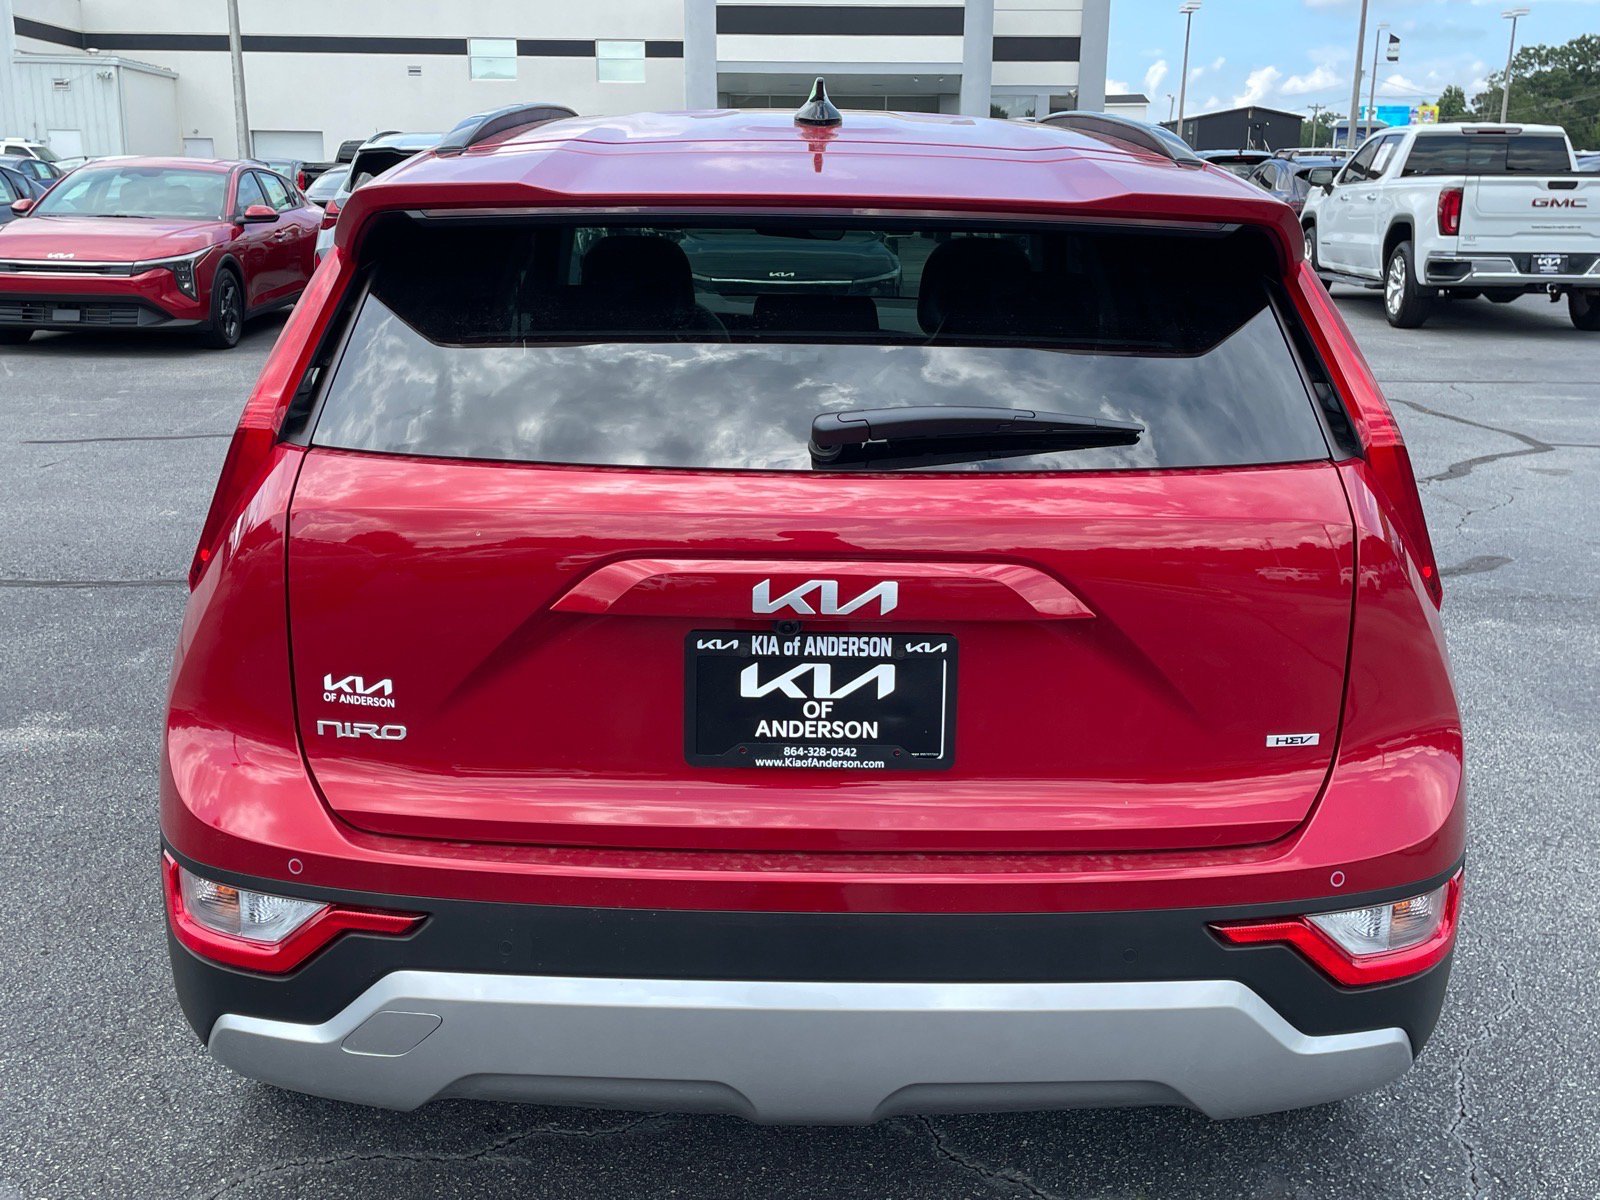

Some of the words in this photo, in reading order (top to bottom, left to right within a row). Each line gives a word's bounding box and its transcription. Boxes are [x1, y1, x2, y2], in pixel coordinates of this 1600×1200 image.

[1532, 198, 1588, 208] GMC
[752, 578, 899, 616] KIA
[696, 638, 739, 650] KIA
[751, 635, 779, 656] KIA
[783, 636, 800, 656] of
[804, 636, 892, 657] ANDERSON
[905, 642, 947, 653] KIA
[323, 673, 393, 696] KIA
[740, 662, 896, 700] KIA
[323, 692, 337, 702] OF
[339, 694, 395, 708] ANDERSON
[802, 701, 834, 719] OF
[316, 720, 407, 741] NIRO
[754, 720, 878, 739] ANDERSON
[1276, 736, 1313, 745] HEV
[783, 747, 857, 757] 864-328-0542
[754, 757, 885, 769] www.KiaofAnderson.com
